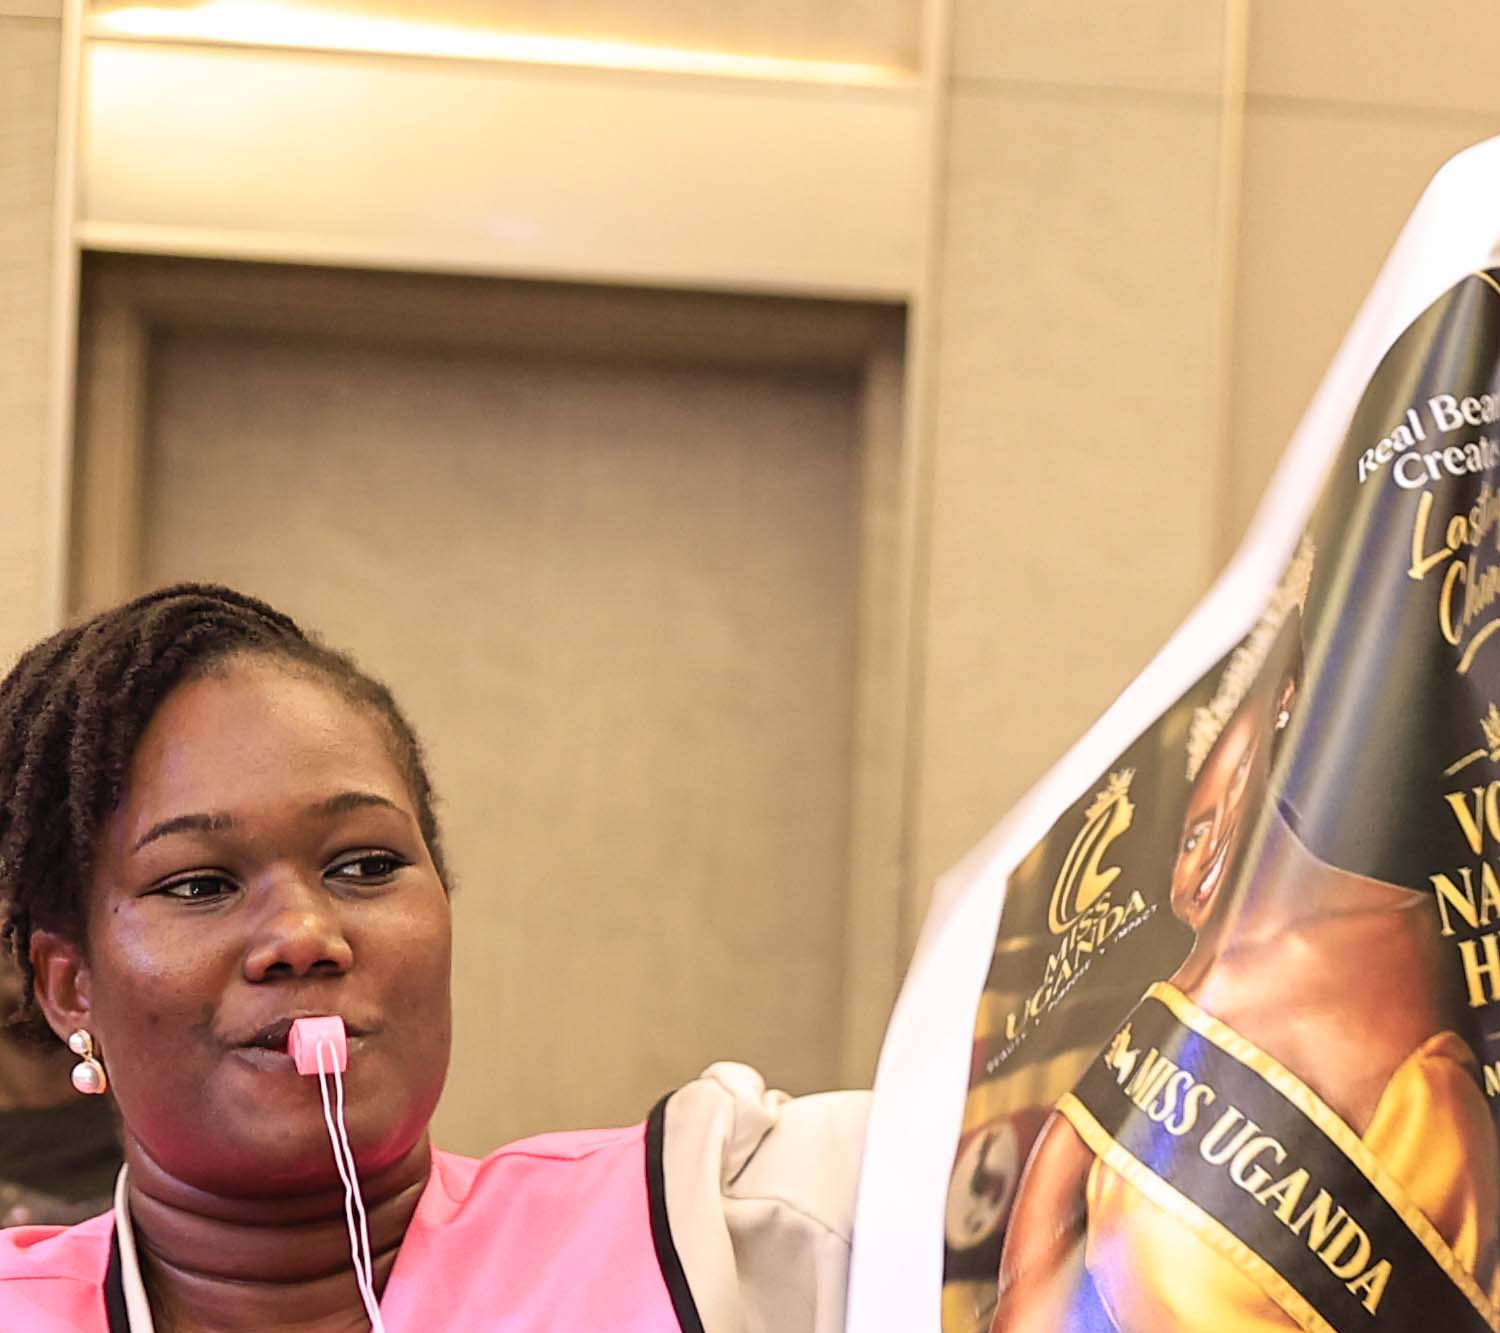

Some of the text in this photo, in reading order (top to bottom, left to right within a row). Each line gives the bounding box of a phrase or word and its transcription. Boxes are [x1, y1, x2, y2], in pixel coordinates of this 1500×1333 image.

[1358, 408, 1426, 484] Real
[1124, 1047, 1393, 1316] MISS UGANDA
